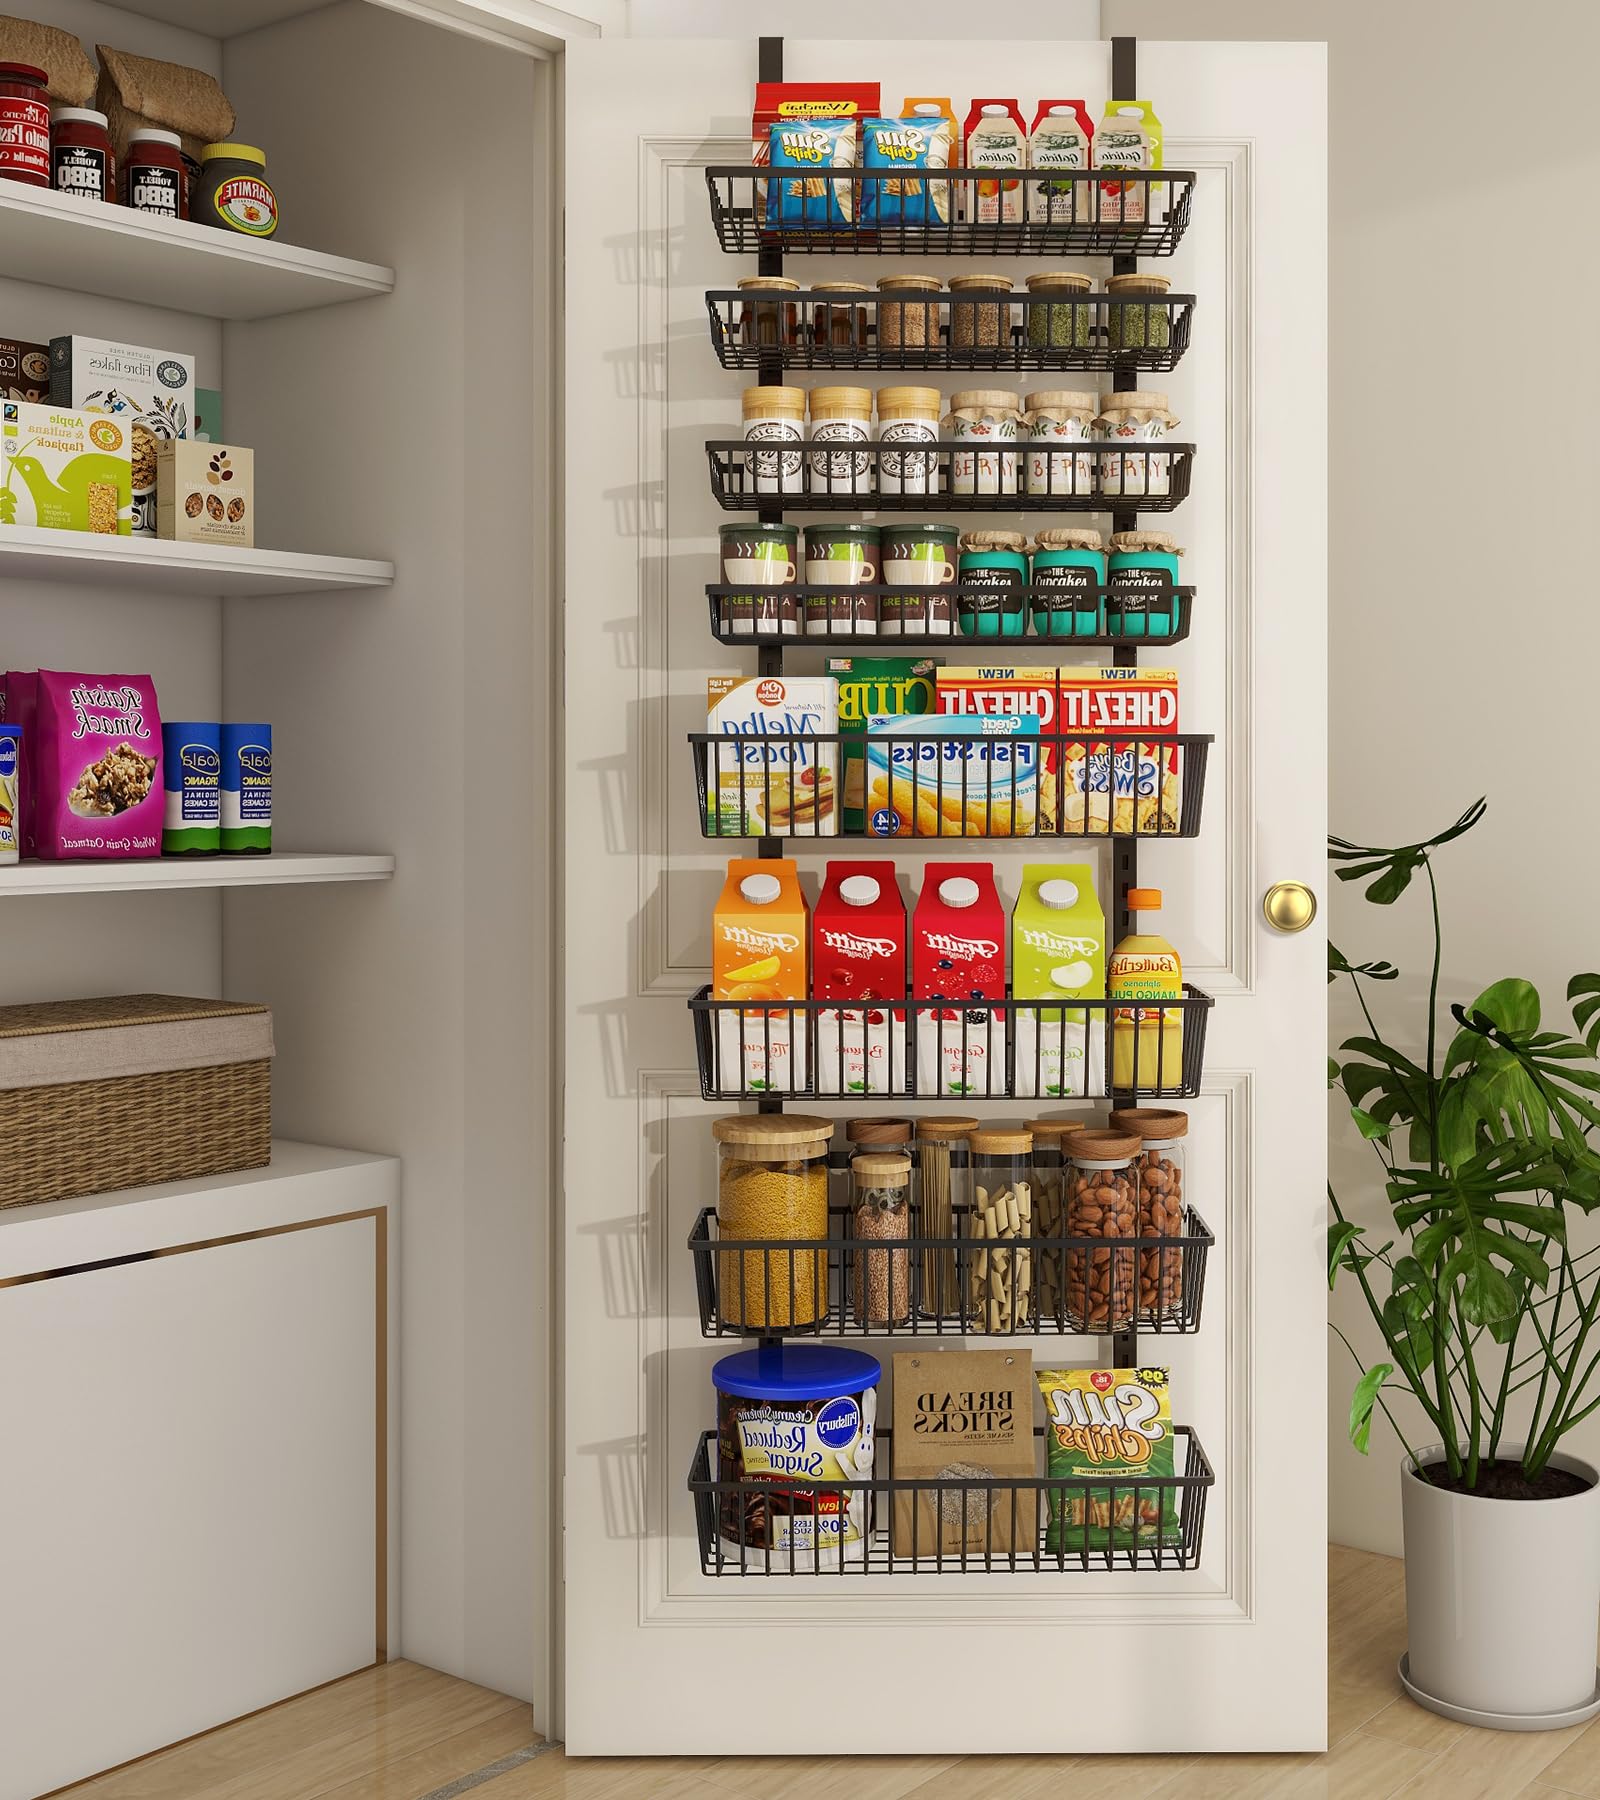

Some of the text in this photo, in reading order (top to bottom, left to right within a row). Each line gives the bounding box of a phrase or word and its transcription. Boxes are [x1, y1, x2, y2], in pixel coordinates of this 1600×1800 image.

[977, 569, 988, 577] THE
[1128, 569, 1140, 577] THE
[767, 596, 790, 606] TA
